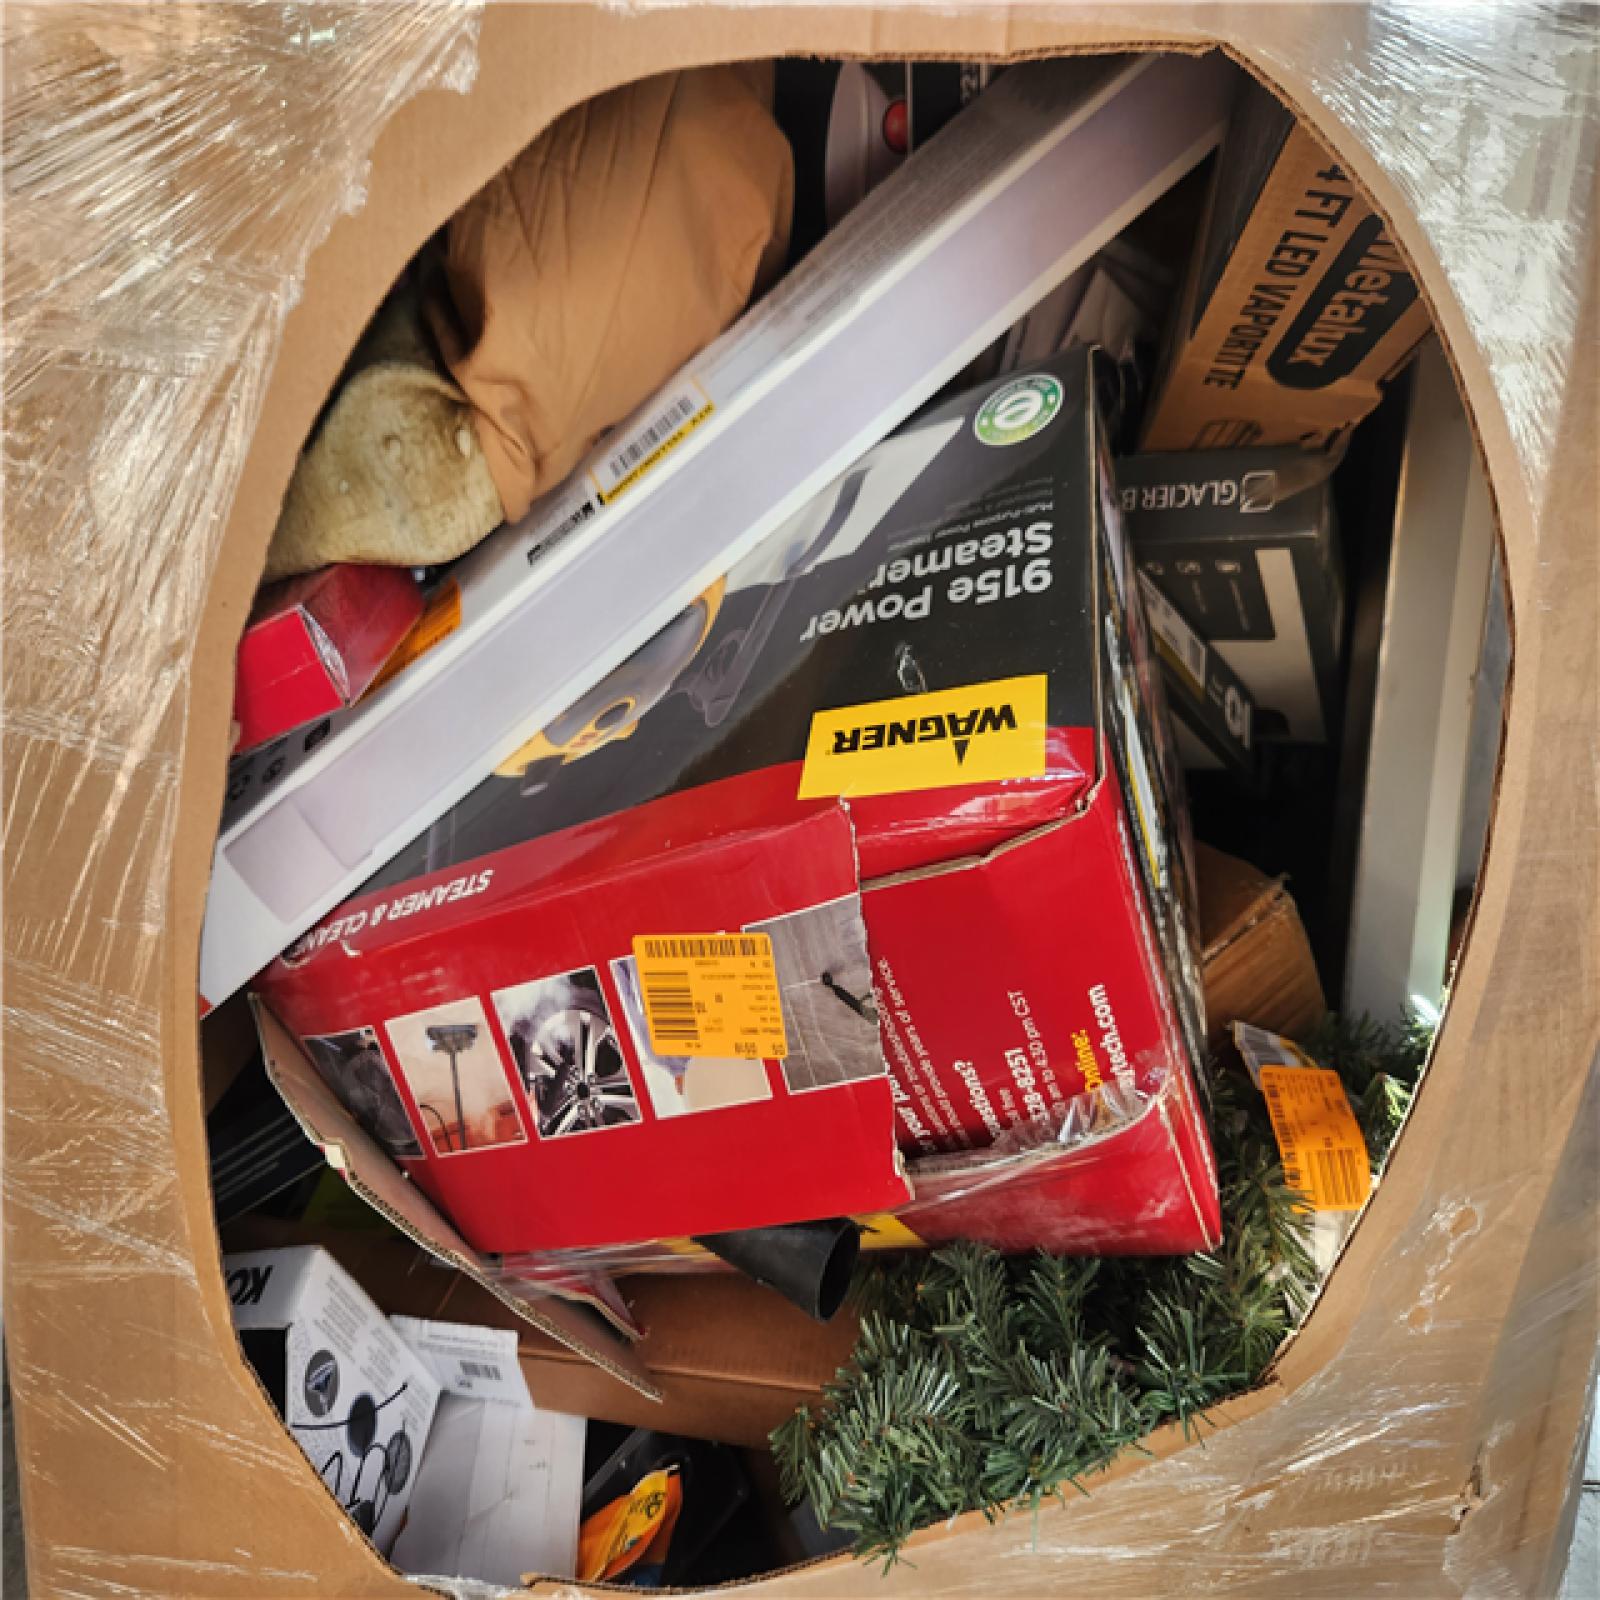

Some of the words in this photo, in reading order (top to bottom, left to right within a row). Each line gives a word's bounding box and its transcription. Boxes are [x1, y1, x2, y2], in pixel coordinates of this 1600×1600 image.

[1294, 189, 1354, 228] FT
[1264, 229, 1329, 277] LED
[1286, 228, 1409, 368] Metalux
[1202, 283, 1298, 391] VAPORTITE
[1142, 479, 1238, 511] GLACIER
[868, 521, 1053, 590] Steamer
[948, 559, 1053, 605] 915e
[799, 585, 934, 643] Power
[832, 704, 1018, 765] WAGNER
[387, 869, 495, 921] STEAMER
[1007, 989, 1031, 1016] CST
